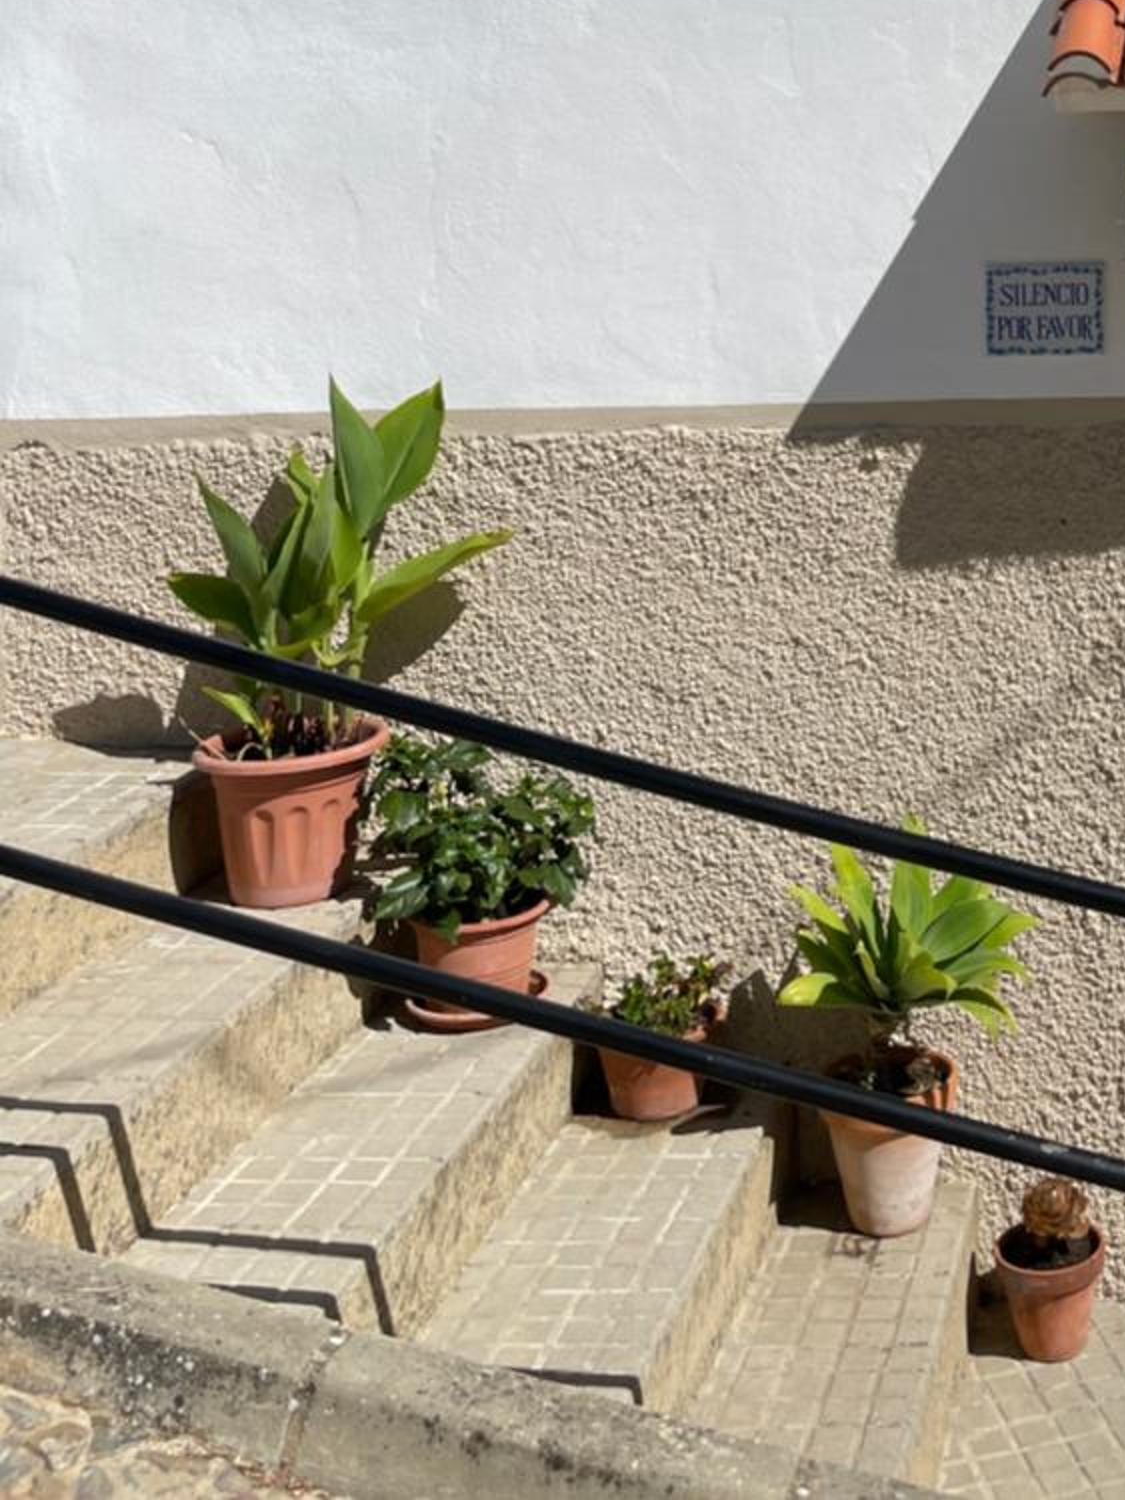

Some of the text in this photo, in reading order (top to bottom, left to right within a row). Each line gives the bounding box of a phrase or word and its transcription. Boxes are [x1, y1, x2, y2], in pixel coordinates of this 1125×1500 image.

[999, 283, 1089, 307] SILENCIO
[997, 315, 1093, 341] POR FAVOR
